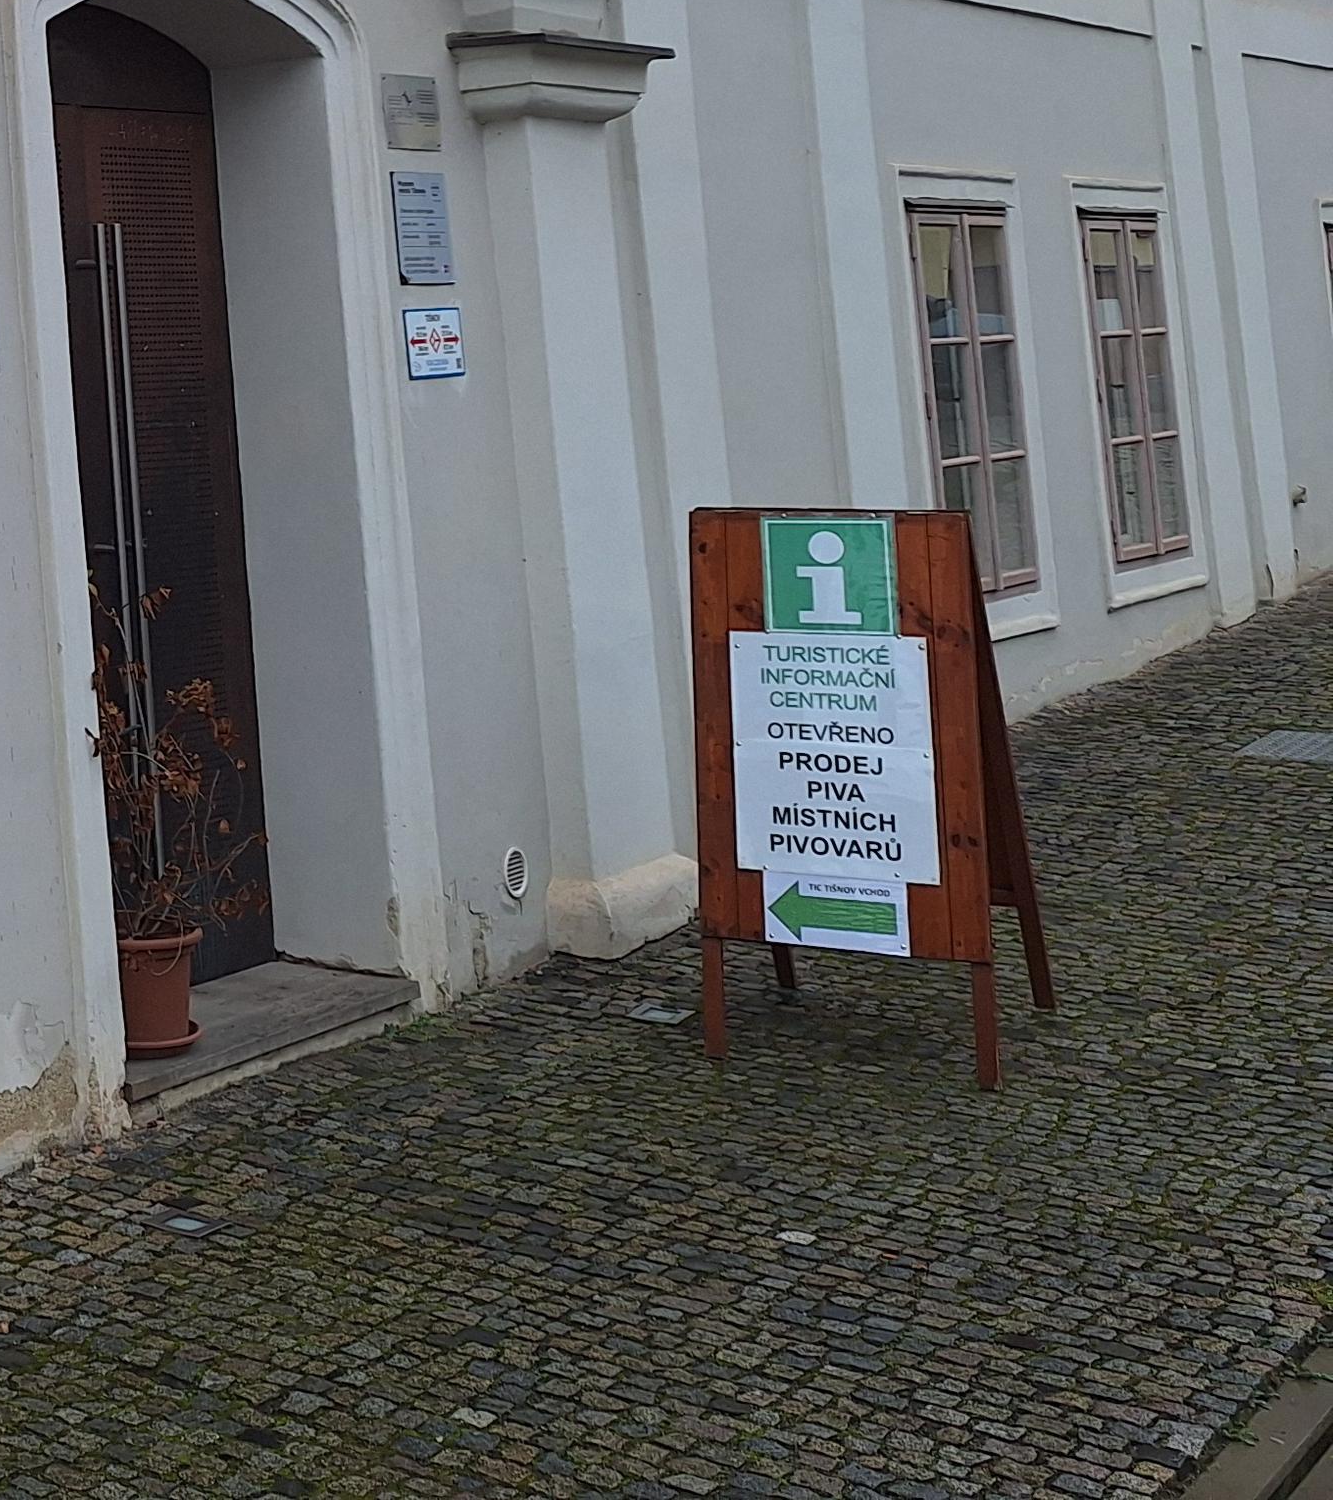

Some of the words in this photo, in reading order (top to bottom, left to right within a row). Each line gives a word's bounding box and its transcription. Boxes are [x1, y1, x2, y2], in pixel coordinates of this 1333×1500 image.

[762, 644, 891, 666] TURISTICKÉ
[760, 667, 896, 689] INFORMAČNÍ
[769, 690, 878, 712] CENTRUM
[767, 720, 895, 745] OTEVŘENO
[778, 751, 884, 776] PRODEJ
[807, 780, 866, 803] PIVA
[771, 802, 897, 833] MÍSTNÍCH
[769, 833, 902, 862] PIVOVARŮ
[808, 883, 822, 892] TIC
[824, 883, 857, 894] TIŠNOV
[858, 888, 891, 898] VCHOD
